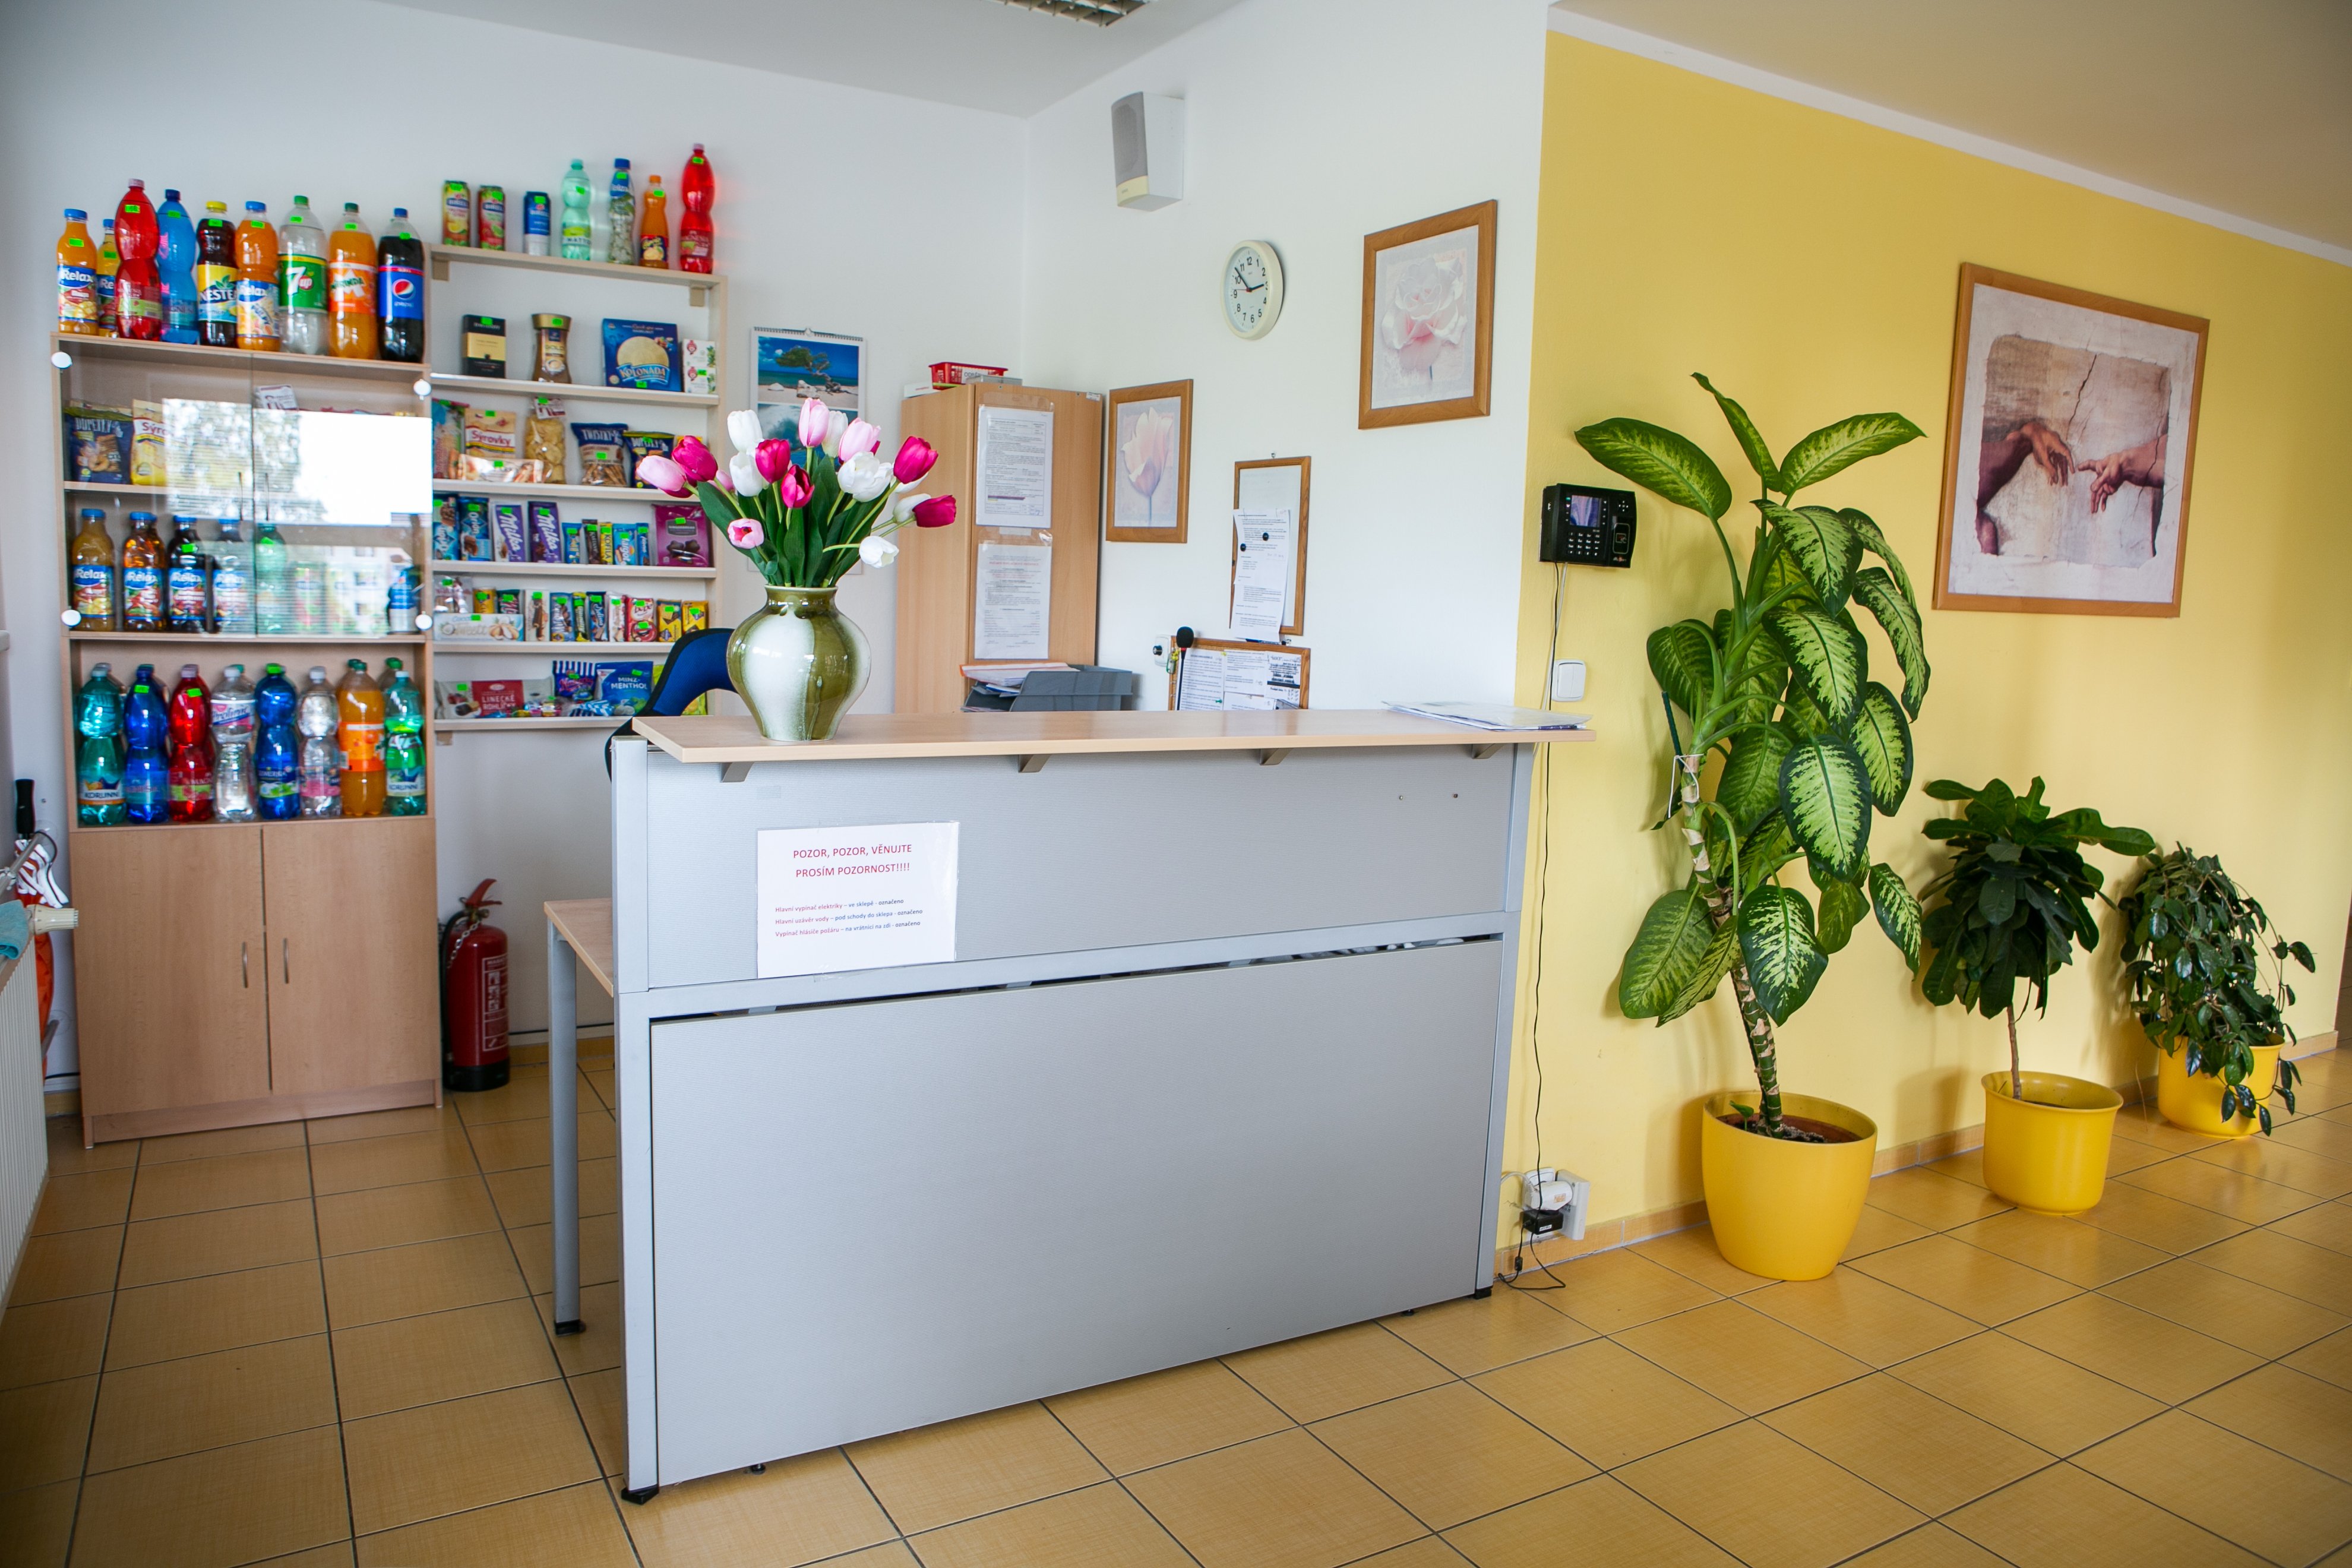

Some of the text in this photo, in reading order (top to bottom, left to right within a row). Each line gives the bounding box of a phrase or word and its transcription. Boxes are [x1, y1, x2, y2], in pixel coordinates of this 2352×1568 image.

[1247, 257, 1252, 265] 12
[1256, 258, 1259, 267] 1
[1240, 263, 1245, 271] 11
[1262, 267, 1266, 276] 2
[61, 267, 94, 282] Relax
[1235, 275, 1241, 284] 10
[1234, 289, 1237, 298] 9
[1237, 304, 1241, 312] 8
[1258, 309, 1262, 317] 5
[1243, 312, 1246, 321] 7
[1250, 314, 1254, 323] 6
[619, 366, 666, 378] KOLONADA
[471, 429, 511, 447] Sýrovky
[469, 511, 480, 535] Orion
[498, 513, 523, 552] Milka
[537, 513, 560, 551] Milka
[75, 569, 106, 580] Relax
[173, 571, 200, 582] Relax
[794, 844, 912, 859] POZOR, POZOR, VĚNUJTE
[796, 862, 910, 877] PROSÍM POZORNOST!!!!
